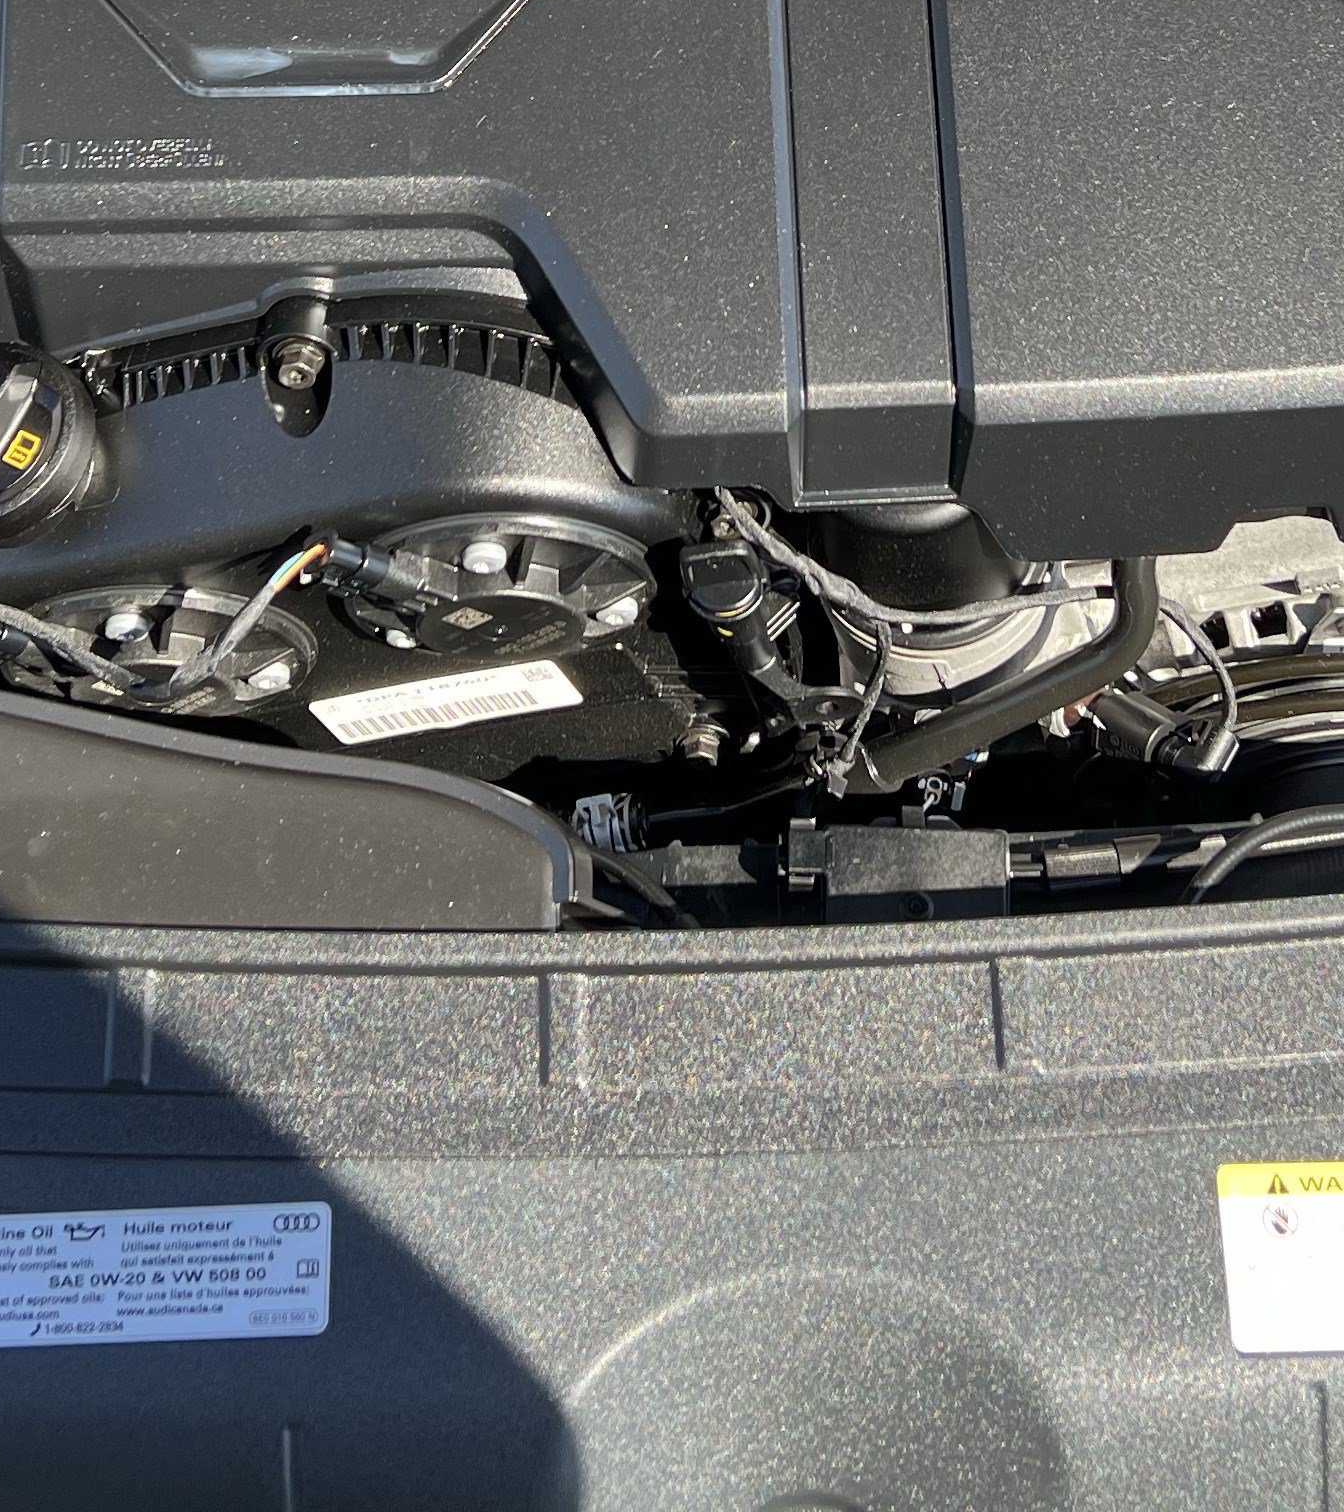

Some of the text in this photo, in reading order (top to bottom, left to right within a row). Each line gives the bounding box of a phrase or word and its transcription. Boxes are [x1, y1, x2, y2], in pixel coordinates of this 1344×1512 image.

[32, 1225, 53, 1239] Oil
[124, 1220, 234, 1235] Huile moteur
[18, 1245, 33, 1257] oil
[36, 1244, 57, 1256] that
[121, 1239, 161, 1252] Utilisez
[164, 1237, 229, 1252] uniquement
[232, 1236, 246, 1248] de
[19, 1260, 68, 1272] complies
[71, 1257, 94, 1269] with
[120, 1257, 138, 1269] qui
[141, 1254, 184, 1266] satisfait
[49, 1267, 266, 1288] SAE 0W-20 & VW 508 00
[12, 1294, 25, 1306] of
[27, 1293, 79, 1307] approved
[117, 1290, 143, 1302] Pour
[146, 1290, 166, 1300] une
[170, 1287, 193, 1300] liste
[116, 1304, 224, 1317] www.audicanada.ca
